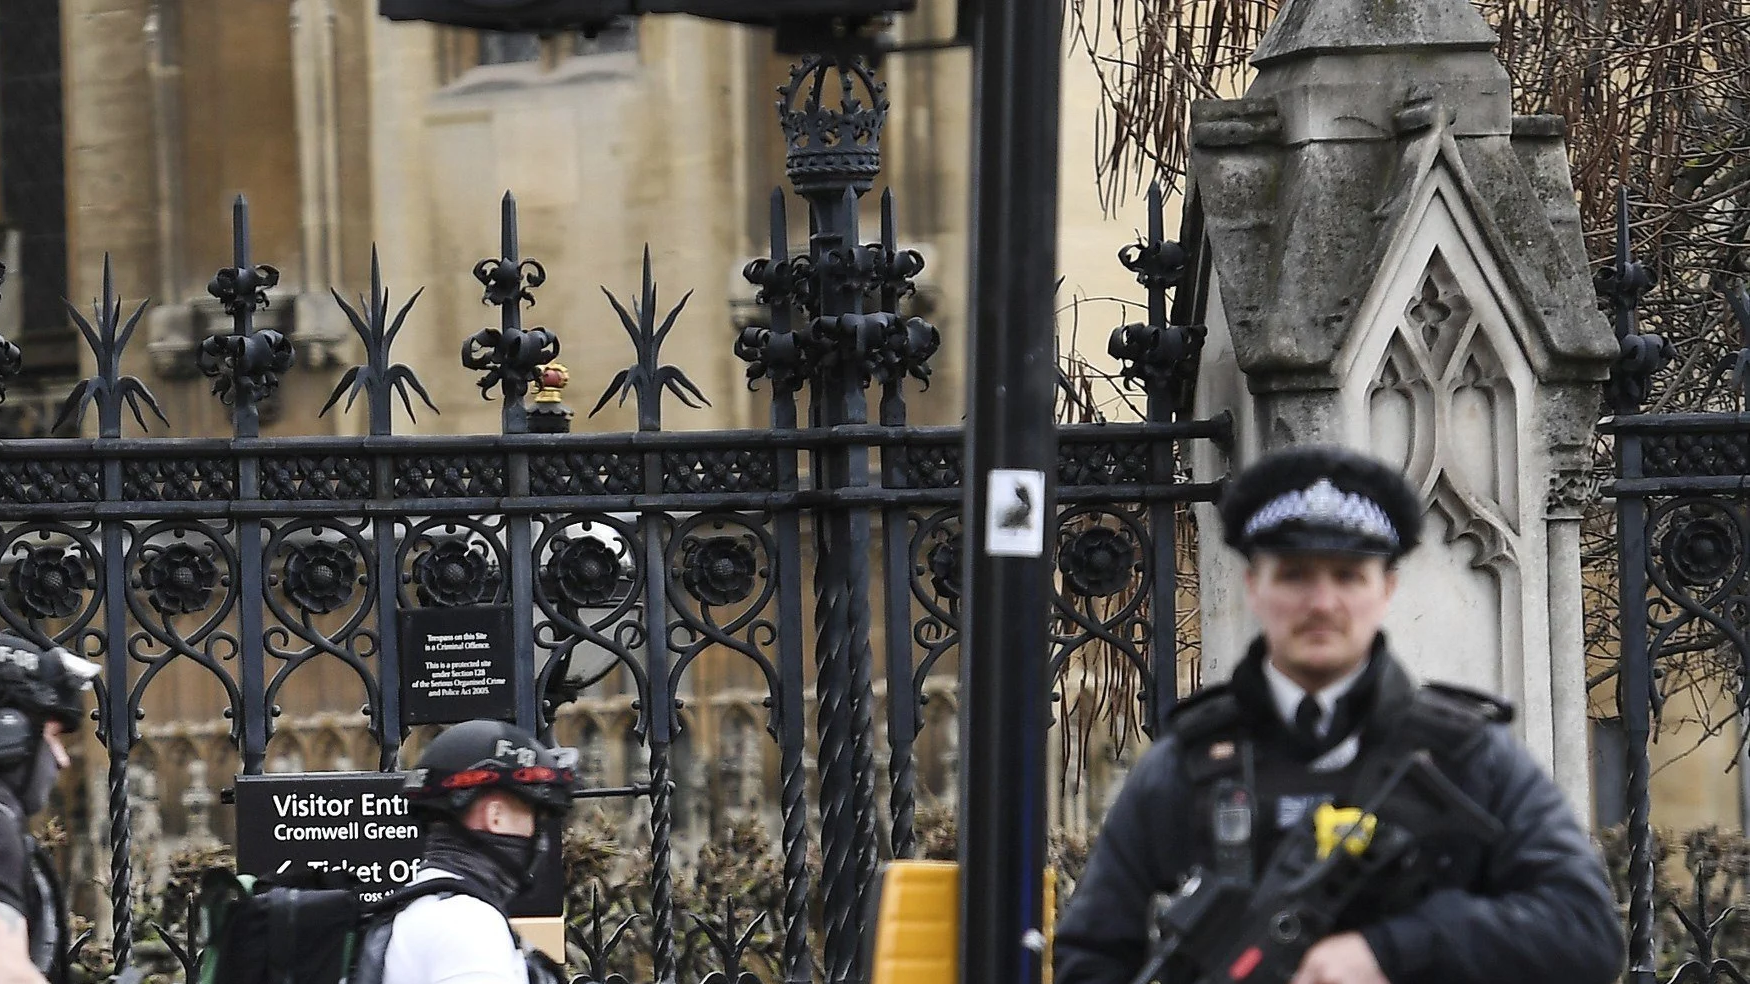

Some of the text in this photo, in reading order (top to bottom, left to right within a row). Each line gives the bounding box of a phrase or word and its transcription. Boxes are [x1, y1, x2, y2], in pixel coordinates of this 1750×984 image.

[436, 642, 464, 651] Criminal
[425, 661, 440, 670] This
[451, 659, 480, 670] protected
[431, 670, 451, 678] under
[451, 670, 474, 678] Section
[419, 680, 430, 688] the
[430, 679, 453, 688] Serious
[486, 677, 506, 685] Crime
[428, 688, 441, 697] and
[441, 688, 460, 696] Police
[460, 687, 472, 695] Act
[273, 793, 354, 817] Visitor
[274, 821, 419, 841] Cromwell Green
[389, 858, 421, 883] Of
